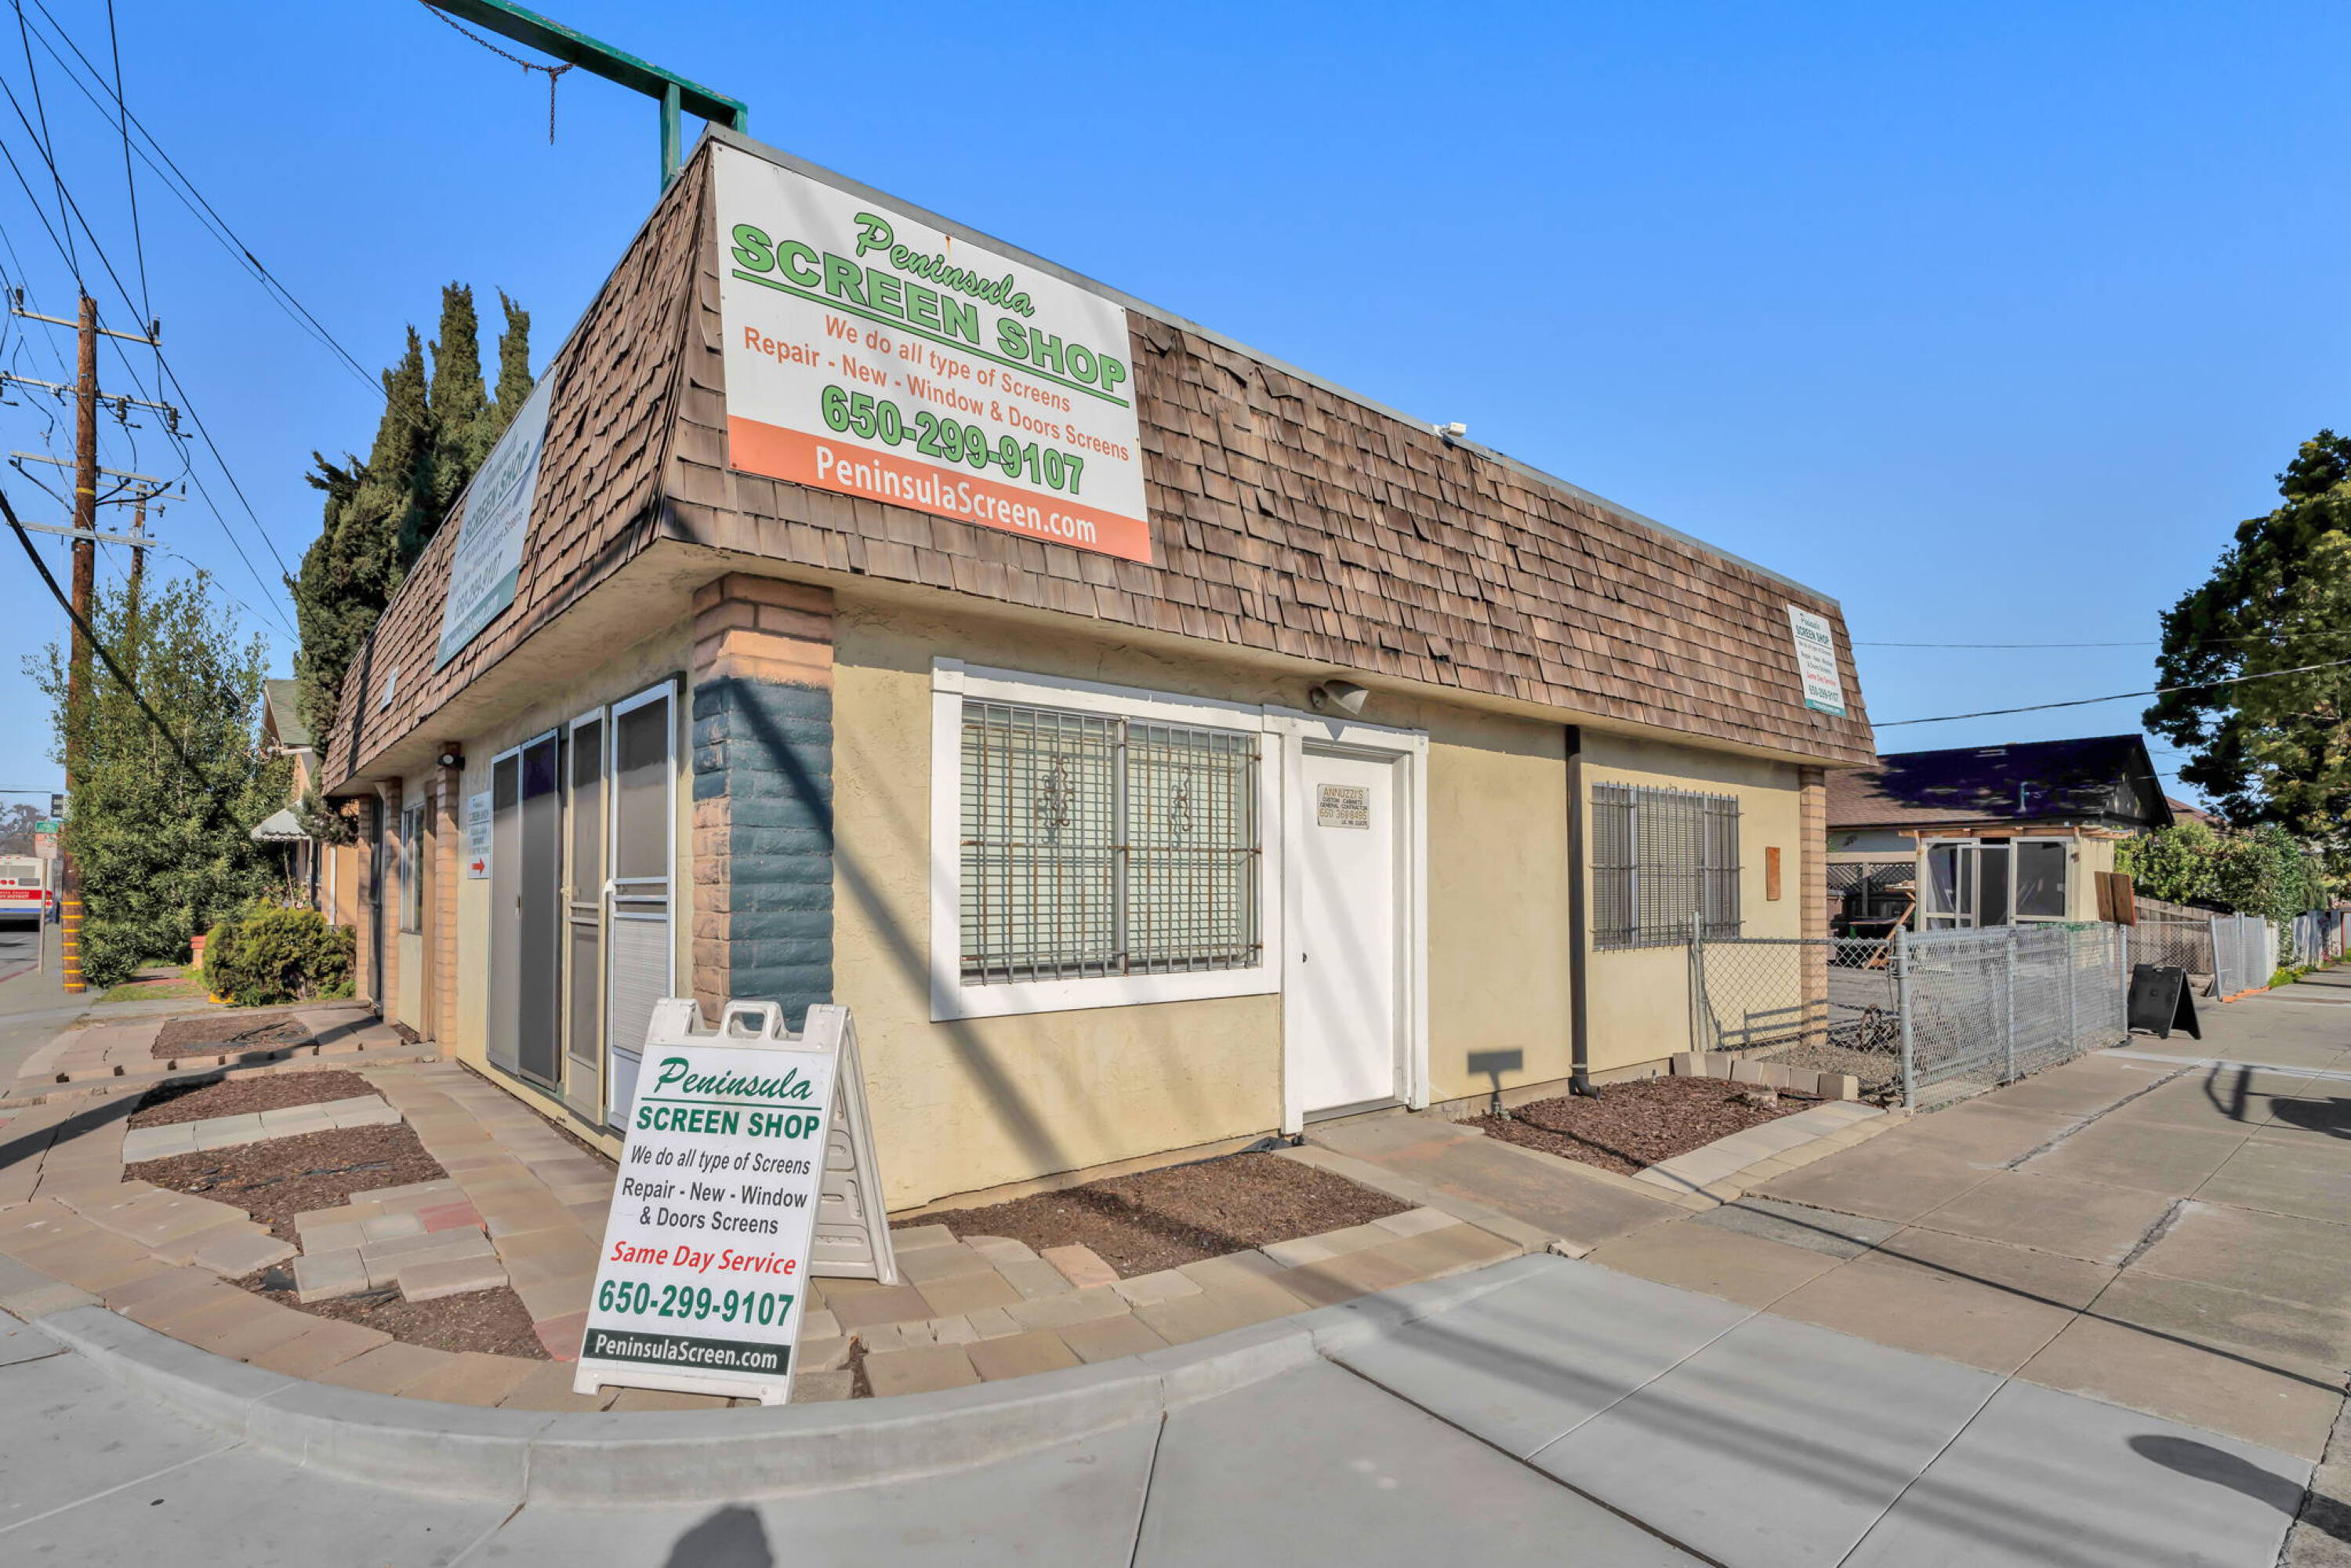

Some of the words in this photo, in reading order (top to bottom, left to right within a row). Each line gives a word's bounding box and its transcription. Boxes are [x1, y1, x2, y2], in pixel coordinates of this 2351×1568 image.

[854, 212, 1035, 317] Peninsula
[731, 223, 980, 345] SCREEN
[996, 317, 1127, 393] SHOP
[825, 315, 858, 343] We
[865, 329, 891, 354] do
[899, 337, 923, 364] all
[929, 350, 971, 381] type
[976, 367, 996, 387] of
[1001, 377, 1071, 412] Screens
[744, 327, 821, 368] Repair
[842, 355, 887, 387] New
[907, 374, 985, 417] Window
[990, 401, 1003, 423] &
[1008, 409, 1061, 440] Doors
[1065, 425, 1130, 462] Screens
[821, 384, 1084, 495] 650-299-9107
[499, 441, 530, 499] SHOP
[815, 445, 1097, 544] PeninsulaScreen.com
[655, 1056, 814, 1101] Peninsula
[637, 1105, 740, 1136] SCREEN
[747, 1112, 821, 1141] SHOP
[629, 1145, 653, 1166] We
[655, 1145, 674, 1167] do
[677, 1147, 696, 1168] all
[699, 1149, 730, 1174] type
[733, 1149, 751, 1171] of
[752, 1152, 811, 1176] Screens
[622, 1177, 675, 1203] Repair
[689, 1181, 726, 1203] New
[741, 1185, 808, 1208] Window
[640, 1207, 651, 1226] &
[656, 1207, 706, 1230] Doors
[710, 1210, 779, 1236] Screens
[610, 1240, 668, 1266] Same
[673, 1245, 714, 1274] Day
[717, 1248, 796, 1276] Service
[598, 1279, 794, 1327] 650-299-9107
[594, 1333, 778, 1370] PeninsulaScreen.com
